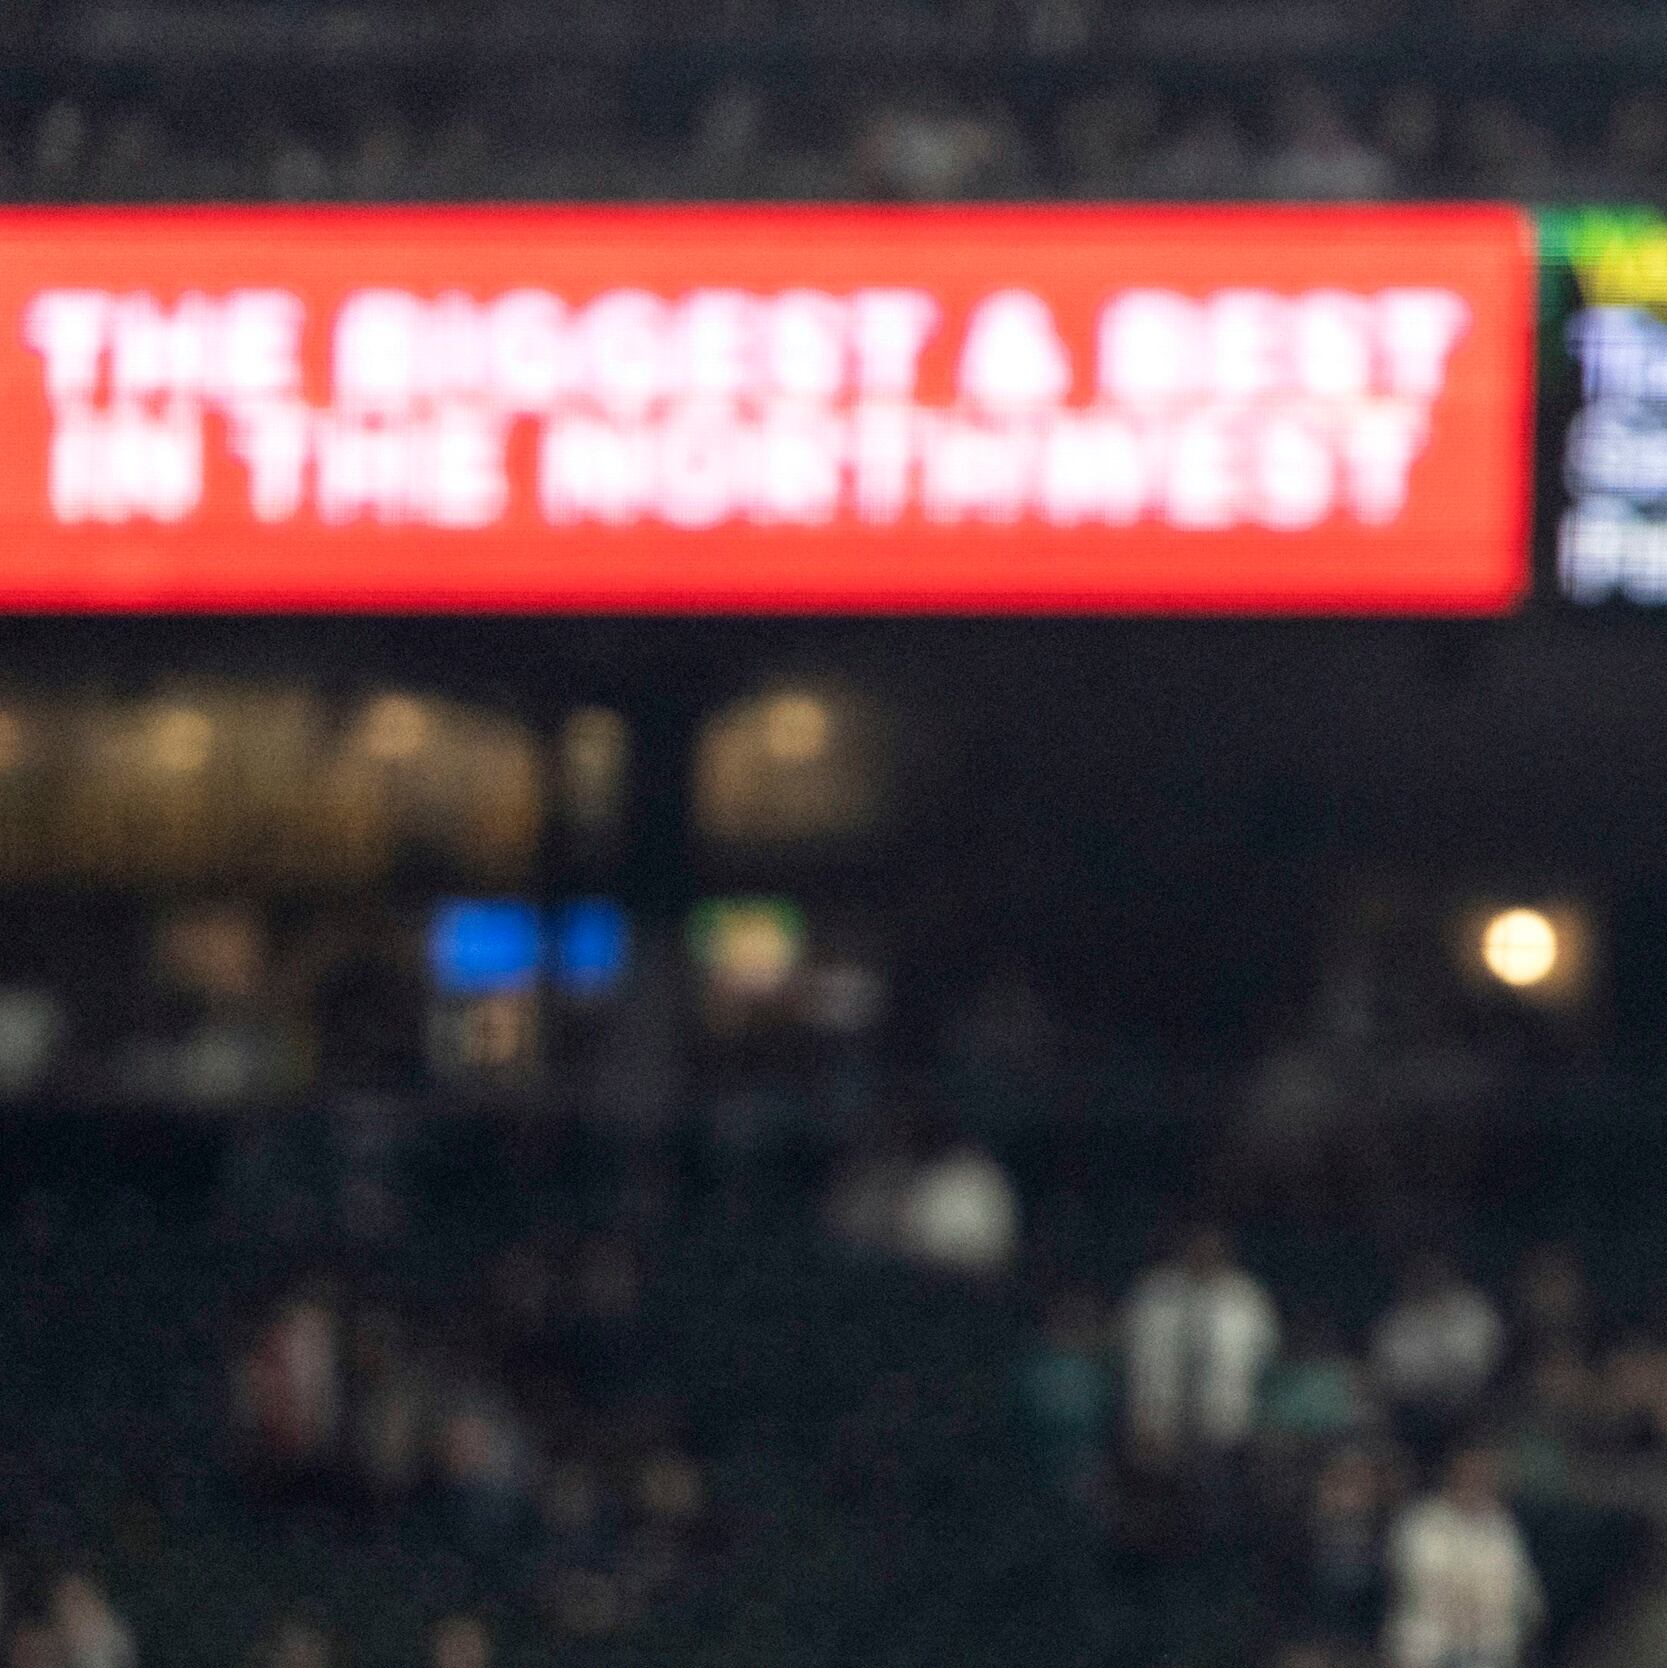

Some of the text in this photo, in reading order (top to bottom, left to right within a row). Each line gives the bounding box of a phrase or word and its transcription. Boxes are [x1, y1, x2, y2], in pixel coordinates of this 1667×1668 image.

[32, 293, 298, 405] THE
[340, 293, 930, 406] BIGGEST
[1105, 293, 1462, 408] BEST
[54, 408, 1425, 526] IN THE NORTHWEST
